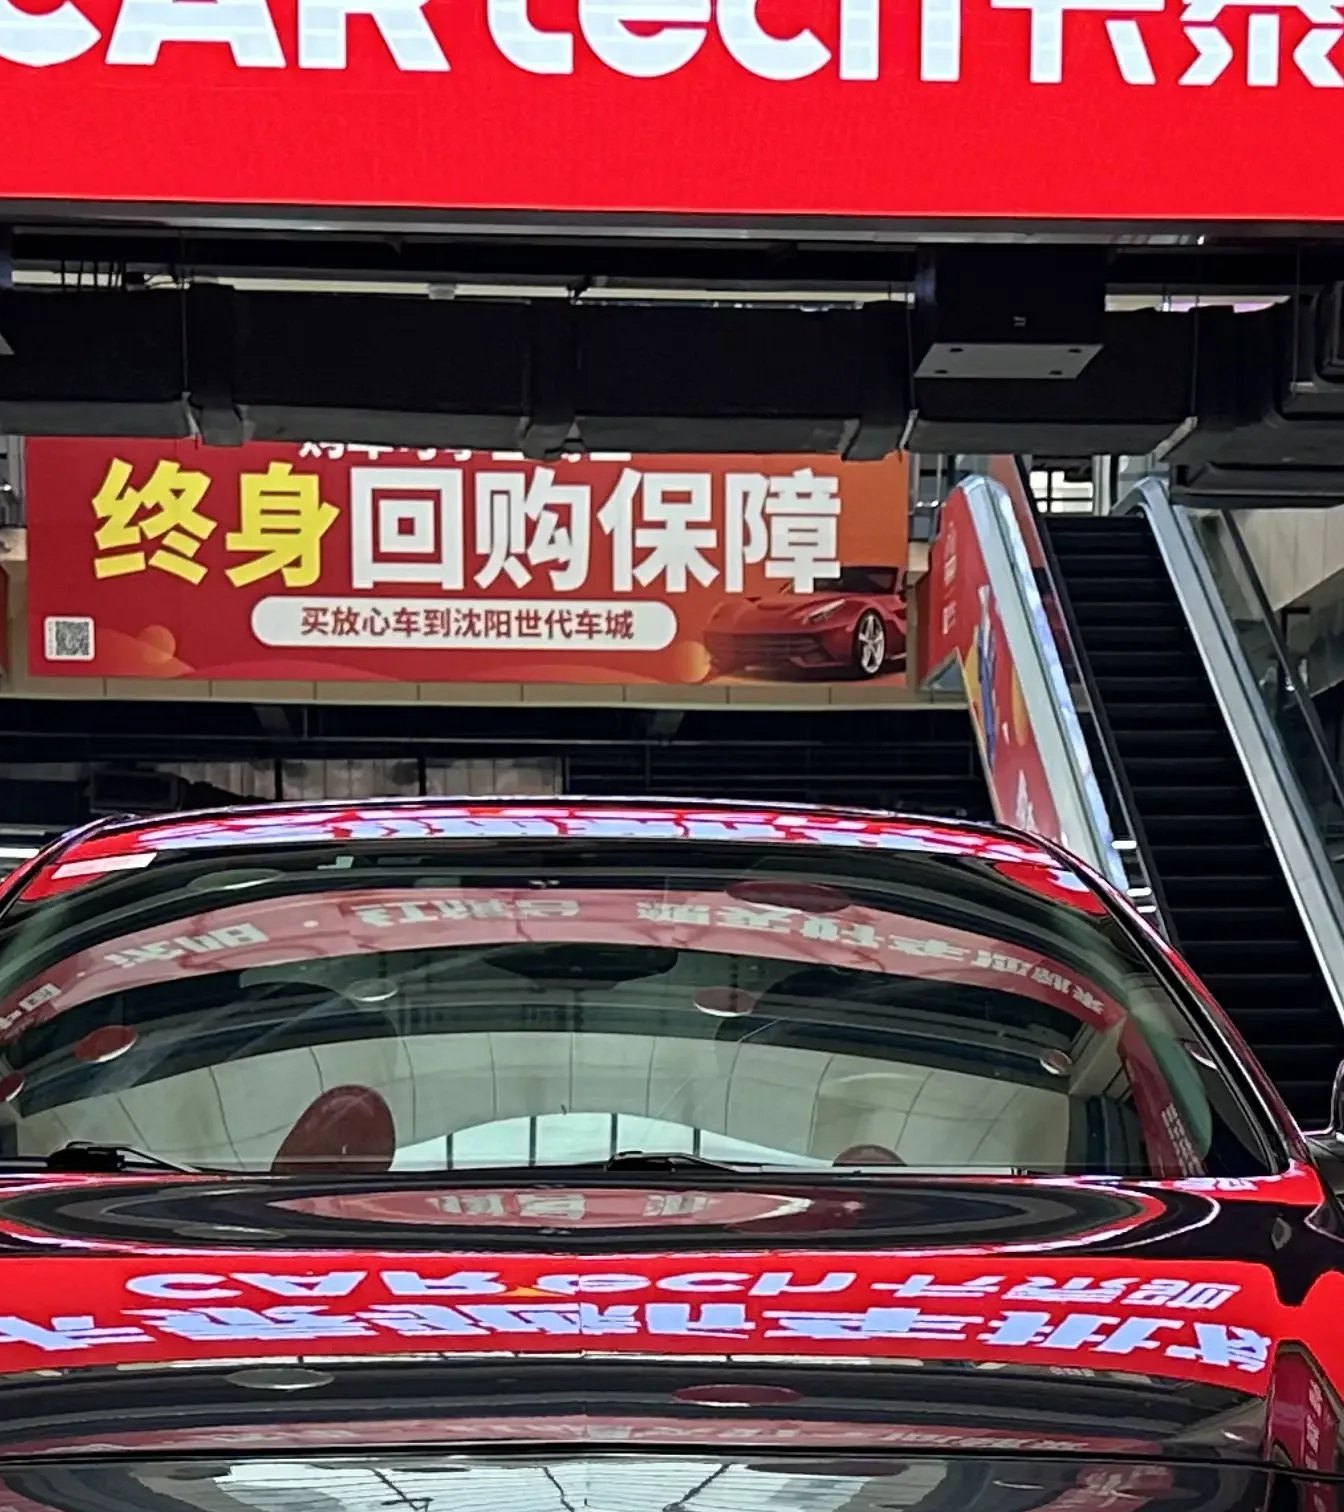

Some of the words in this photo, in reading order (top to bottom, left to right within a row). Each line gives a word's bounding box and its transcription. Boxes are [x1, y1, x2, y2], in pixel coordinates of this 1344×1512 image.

[92, 457, 842, 593] 终身回购保障
[301, 606, 635, 640] 买放心车到沈阳世代车城
